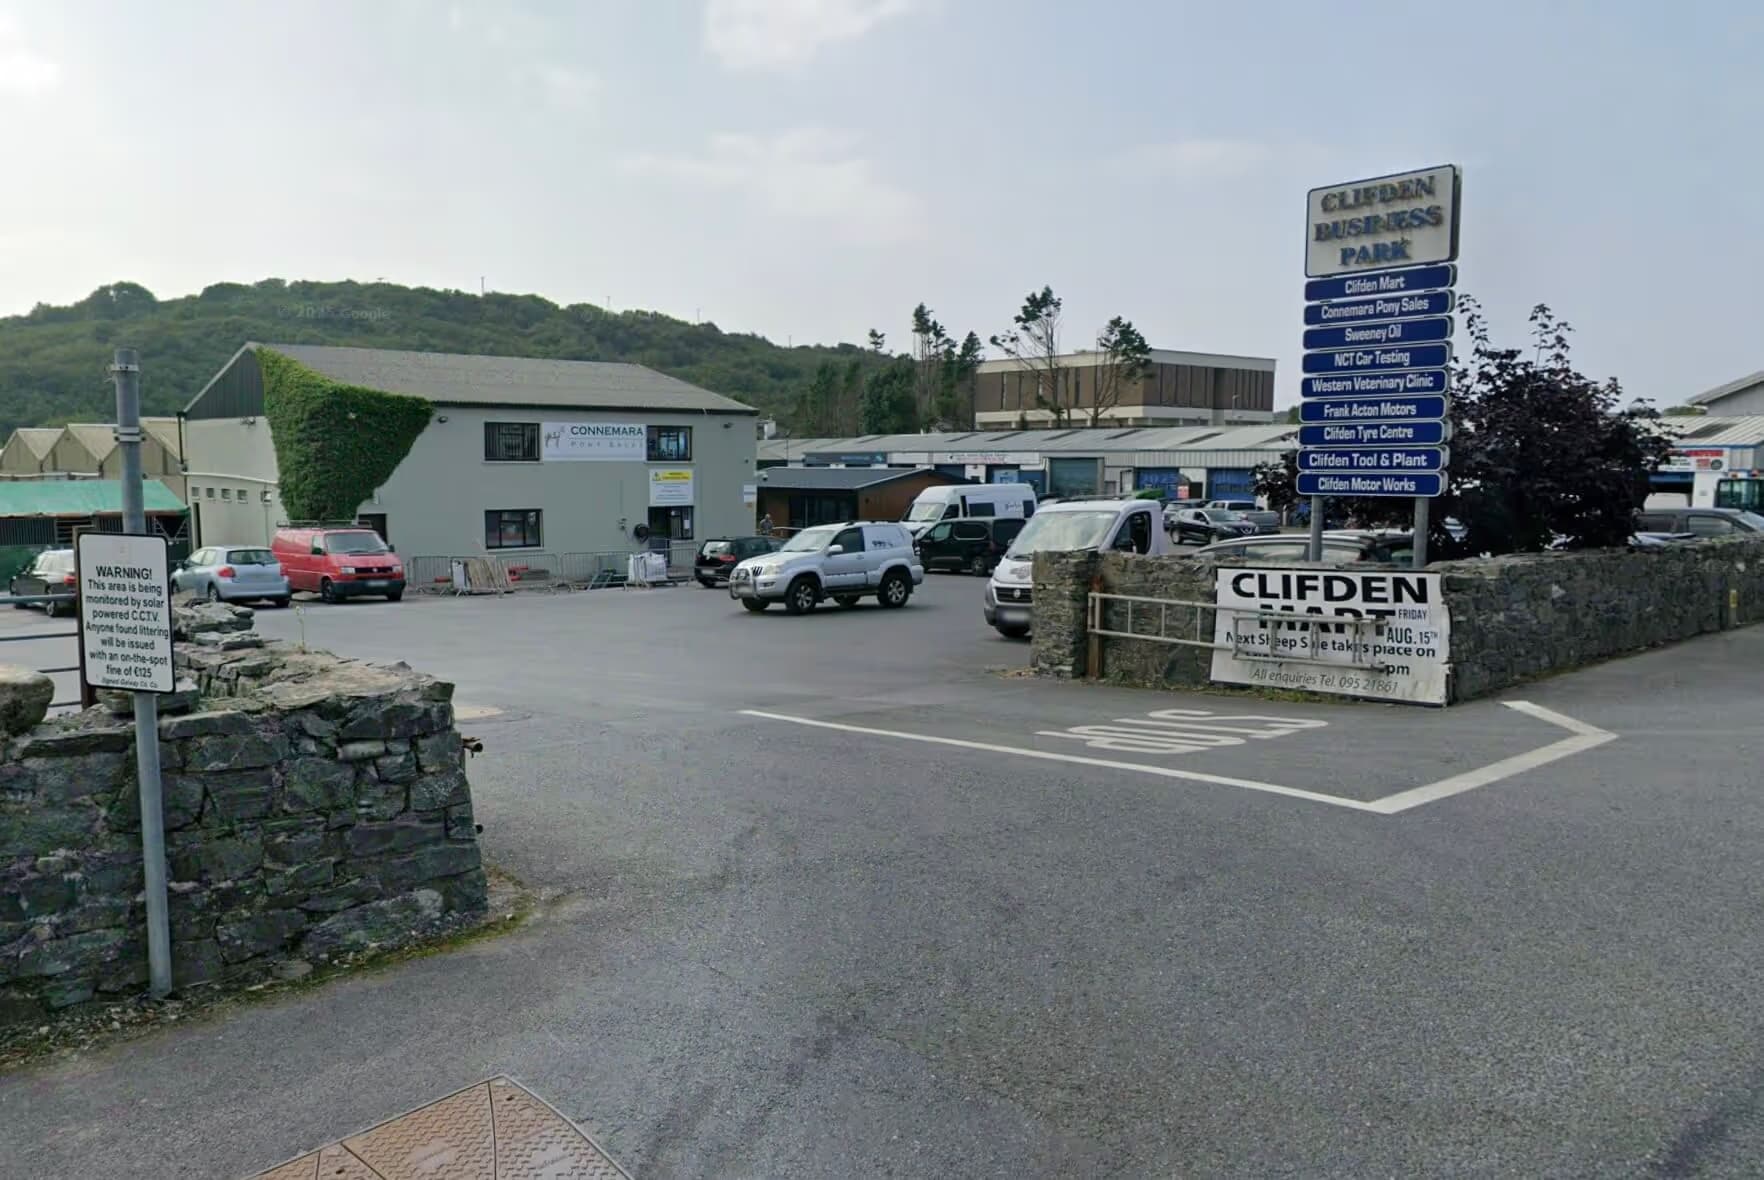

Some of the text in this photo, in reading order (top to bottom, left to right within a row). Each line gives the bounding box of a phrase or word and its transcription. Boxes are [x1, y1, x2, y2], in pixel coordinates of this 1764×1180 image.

[1320, 175, 1436, 212] CLIFDEN
[1314, 204, 1444, 242] BUSINESS
[1338, 236, 1412, 266] PARK
[1345, 275, 1406, 294] Clifden Mart
[1321, 297, 1429, 319] Connemara Pony Sales
[1345, 324, 1402, 342] Sweeney Oil
[1334, 350, 1410, 366] NCT Car Testing
[1312, 374, 1434, 392] Western Veterinary Clinic
[1324, 402, 1416, 418] Frank Acton Motors
[570, 426, 644, 436] CONNEMARA
[1324, 426, 1414, 443] Clifden Tyre Centre
[1309, 453, 1427, 467] Clifden Tool & Plant
[1318, 477, 1416, 491] Clifden Motor Works
[96, 565, 152, 580] WARNING!
[88, 579, 162, 596] This area is being
[1232, 573, 1428, 604] CLIFDEN
[86, 594, 165, 609] monitored by solar
[92, 610, 129, 623] powered
[1398, 609, 1428, 621] FRIDAY
[86, 621, 169, 640] Anyone found littering
[1386, 627, 1417, 645] AUG.
[100, 637, 155, 650] will be issued
[1416, 647, 1436, 657] on
[89, 651, 168, 667] with an on-the-spot
[106, 666, 152, 678] fine of €125
[1252, 668, 1398, 693] All enquiries Tel. 095 21861
[1034, 709, 1329, 754] STOP
